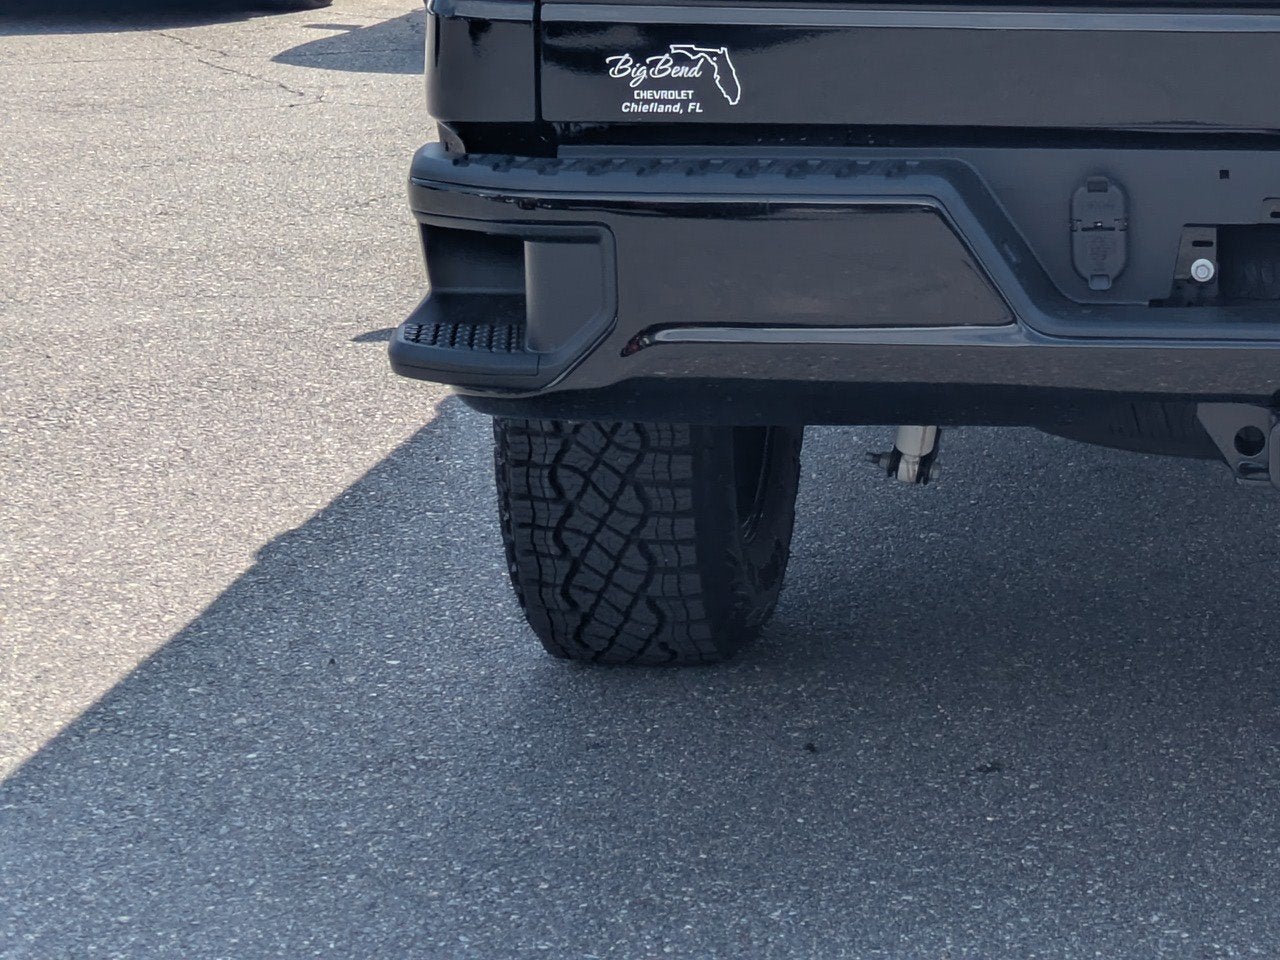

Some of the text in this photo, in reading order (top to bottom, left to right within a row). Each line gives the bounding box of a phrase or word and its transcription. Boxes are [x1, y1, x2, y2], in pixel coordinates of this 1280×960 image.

[605, 53, 704, 87] Big Bend
[633, 90, 694, 99] CHEVROLET
[621, 102, 703, 114] Chiefland, FL
